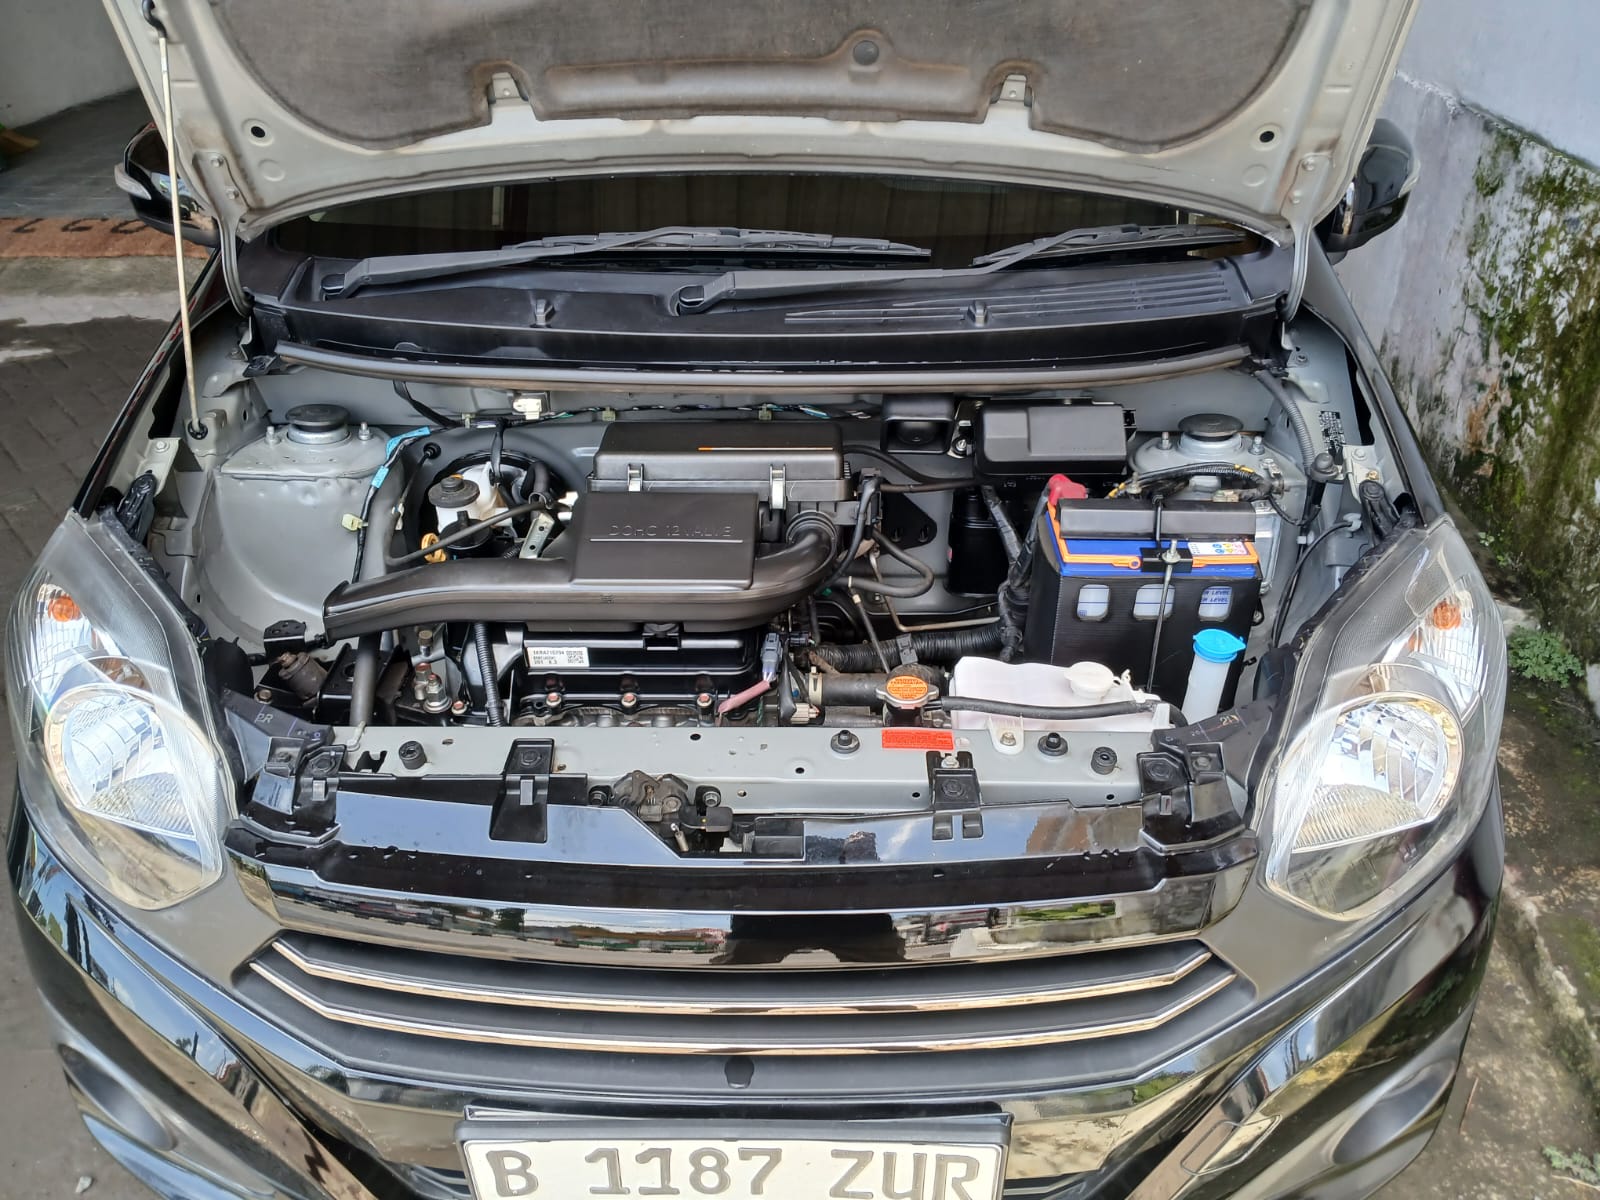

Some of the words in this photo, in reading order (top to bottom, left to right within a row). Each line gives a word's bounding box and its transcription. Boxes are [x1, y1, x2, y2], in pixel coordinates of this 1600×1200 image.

[608, 525, 657, 537] DOHC
[665, 525, 681, 537] 12
[486, 1149, 540, 1197] B
[584, 1147, 782, 1196] 1187
[829, 1148, 981, 1200] ZUR
